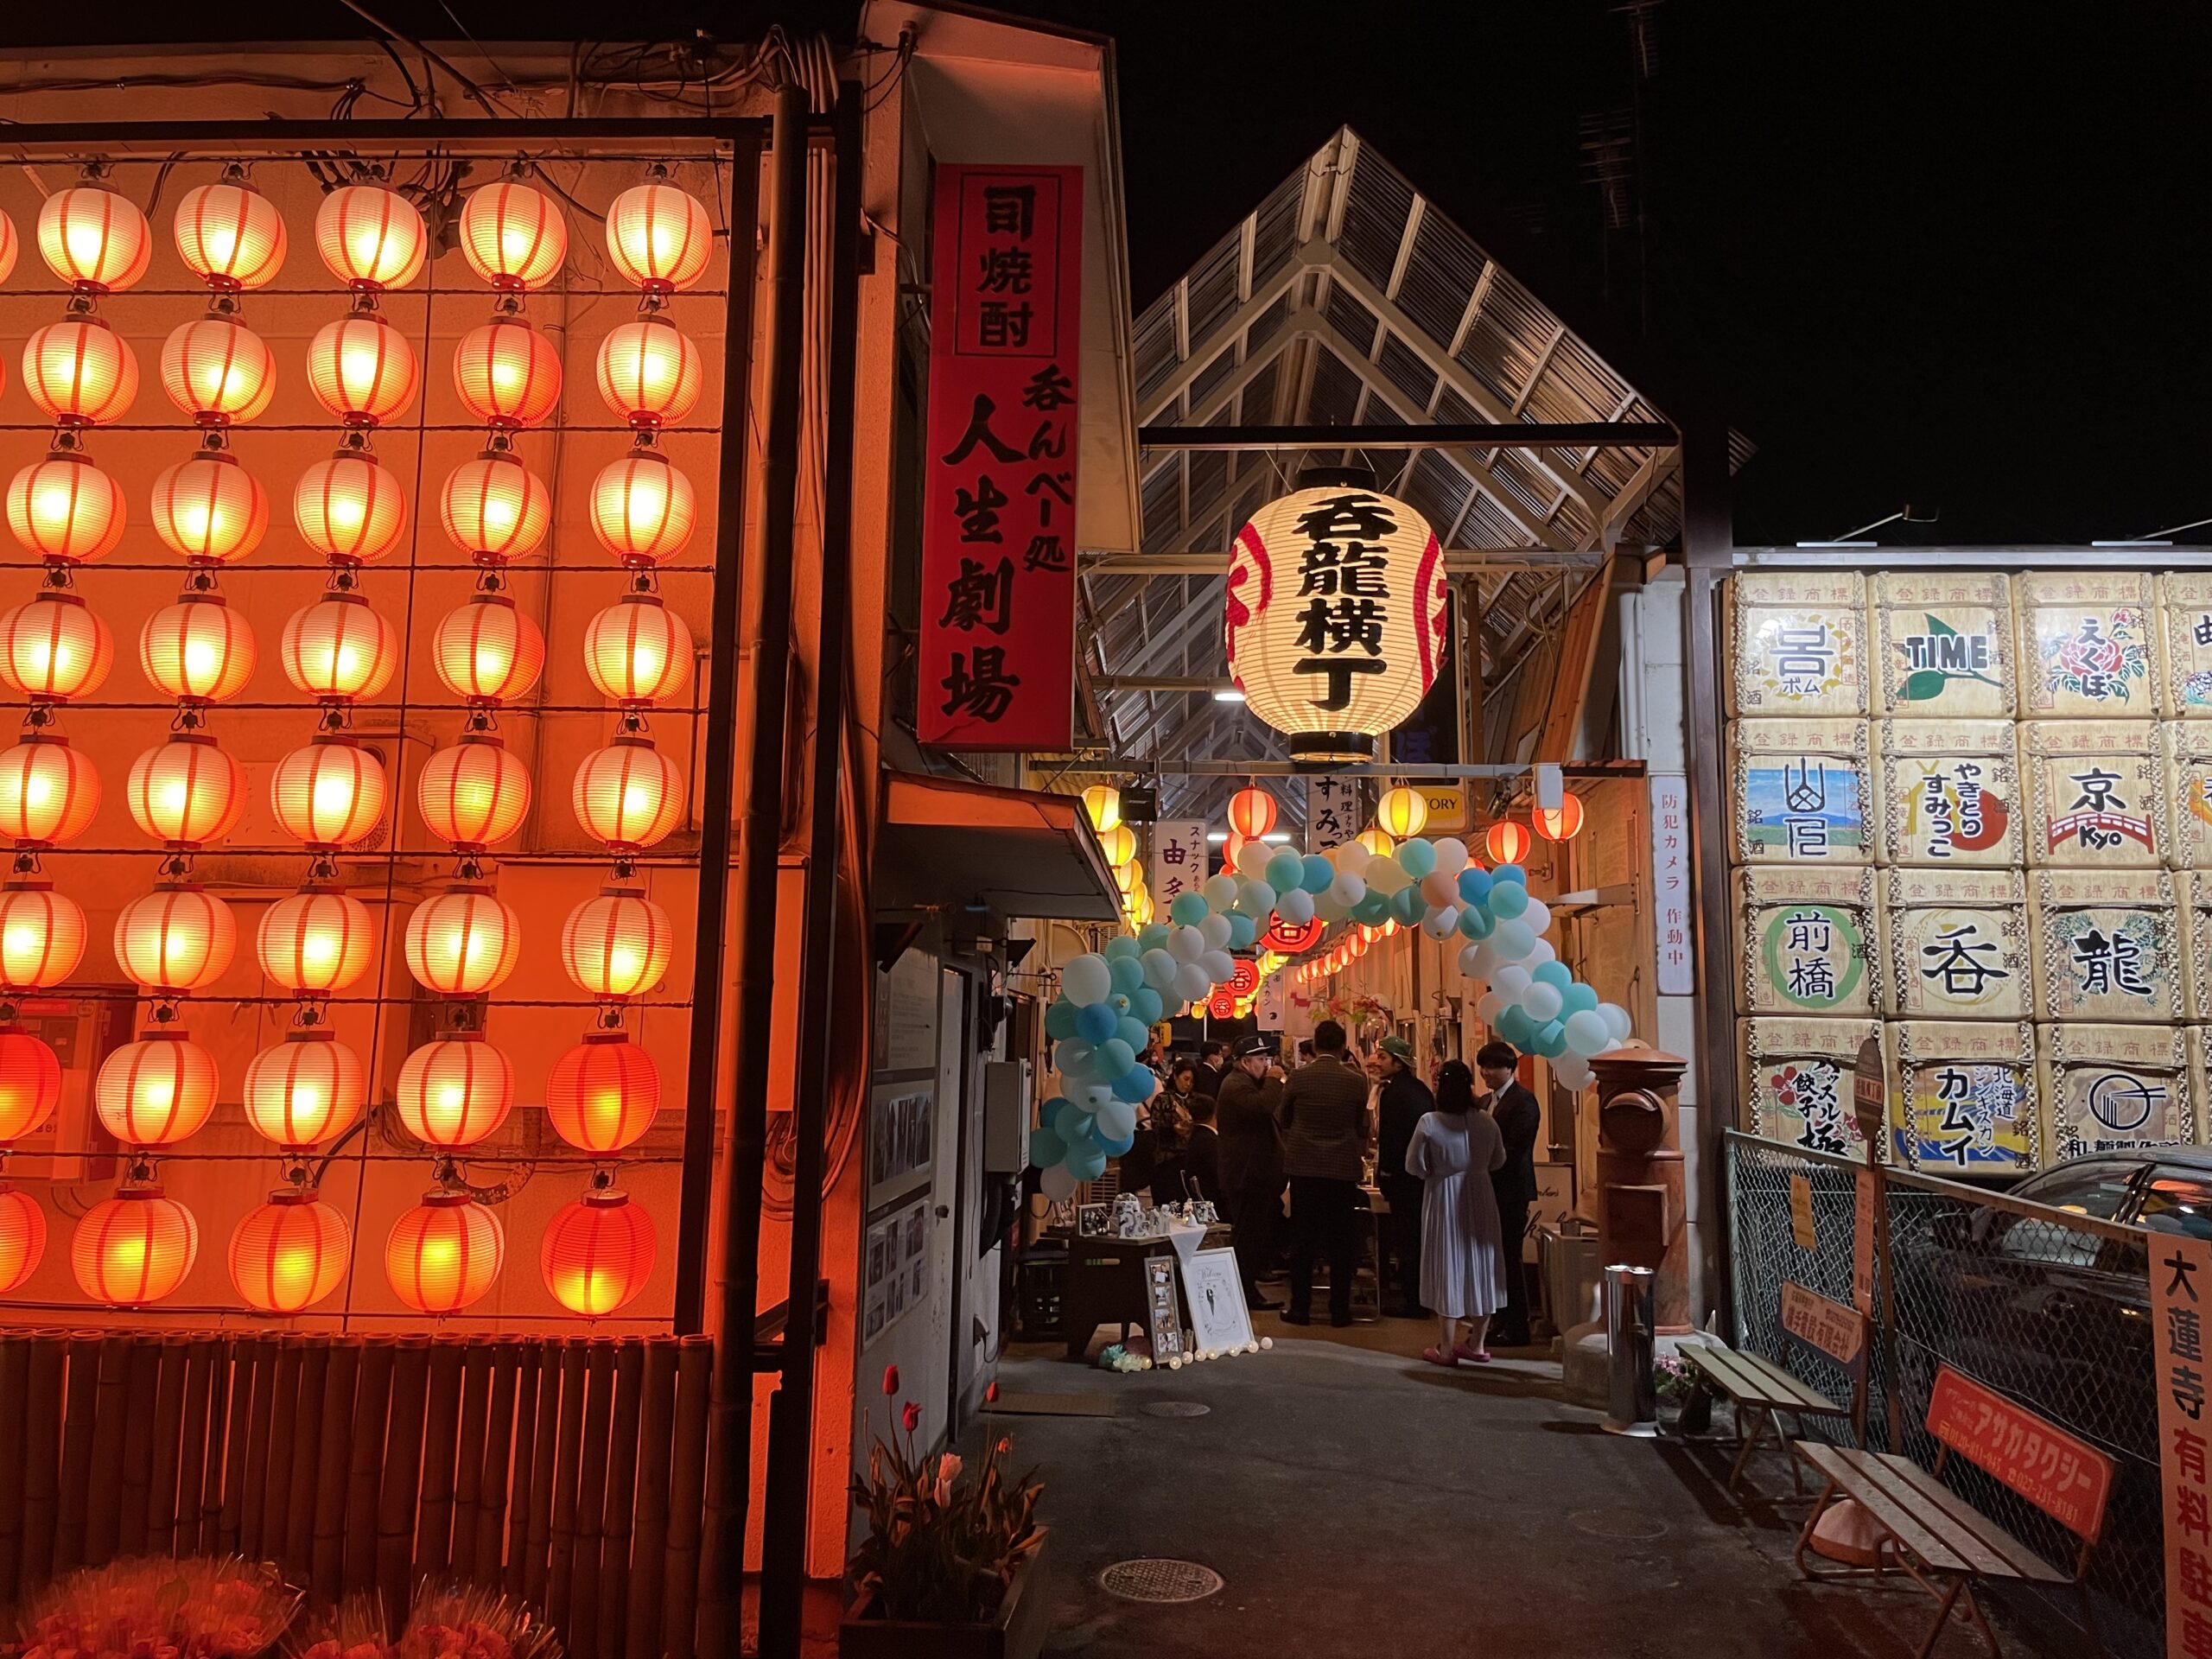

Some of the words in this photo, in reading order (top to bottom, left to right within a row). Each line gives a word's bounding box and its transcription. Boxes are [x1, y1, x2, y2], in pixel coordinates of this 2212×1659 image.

[1022, 364, 1077, 572] 呑んべー処
[938, 393, 1028, 723] 人生劇場
[1291, 493, 1398, 712] 呑龍横丁
[1782, 677, 1821, 694] ボム
[1905, 636, 1989, 671] TIME
[2077, 618, 2114, 697] えくぼ
[1923, 774, 1954, 858] すみっこ
[1954, 763, 1982, 836] やきとり
[2069, 767, 2127, 812] 京
[1190, 826, 1200, 873] スナック
[2079, 825, 2123, 850] Kyo
[1785, 911, 1834, 999] 前橋
[1921, 925, 2011, 995] 呑
[2073, 930, 2153, 995] 龍
[1792, 1072, 1821, 1118] 餃子
[1936, 1068, 1975, 1166] カムイ
[1974, 1066, 1995, 1155] ジンギスカン
[1993, 1067, 2017, 1120] 北海道
[1974, 1402, 2092, 1492] アサカタクシー
